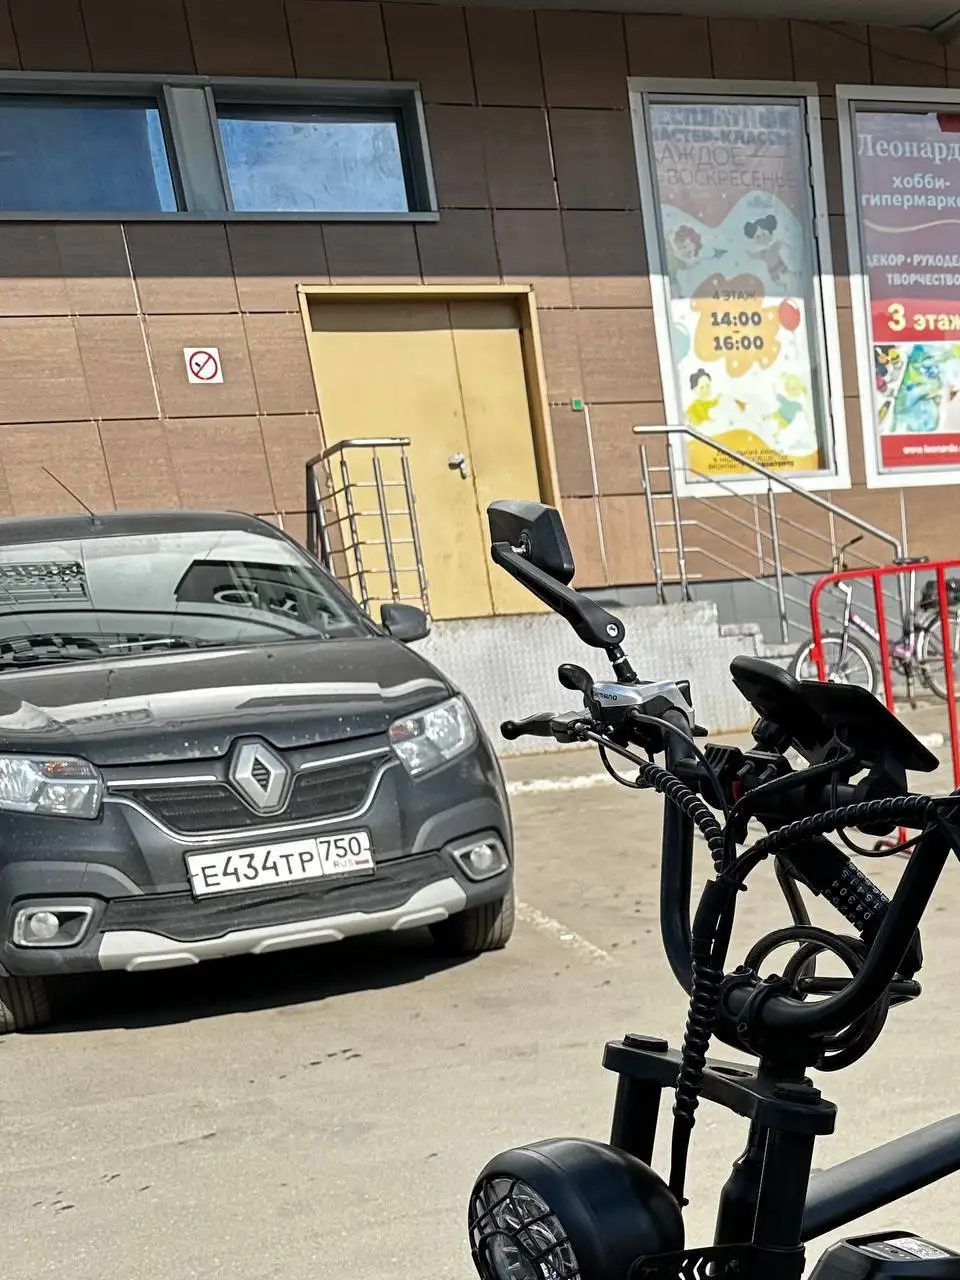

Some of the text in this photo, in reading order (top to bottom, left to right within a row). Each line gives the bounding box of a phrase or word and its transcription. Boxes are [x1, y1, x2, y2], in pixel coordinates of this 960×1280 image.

[656, 143, 746, 169] АЖДОЕ
[892, 173, 951, 189] хобби-
[722, 289, 757, 301] ЭТАЖ
[711, 311, 762, 326] 14:00
[887, 303, 906, 331] 3
[713, 336, 764, 351] 16:00
[201, 836, 361, 888] Е434ТР 750
[333, 858, 355, 868] RUS
